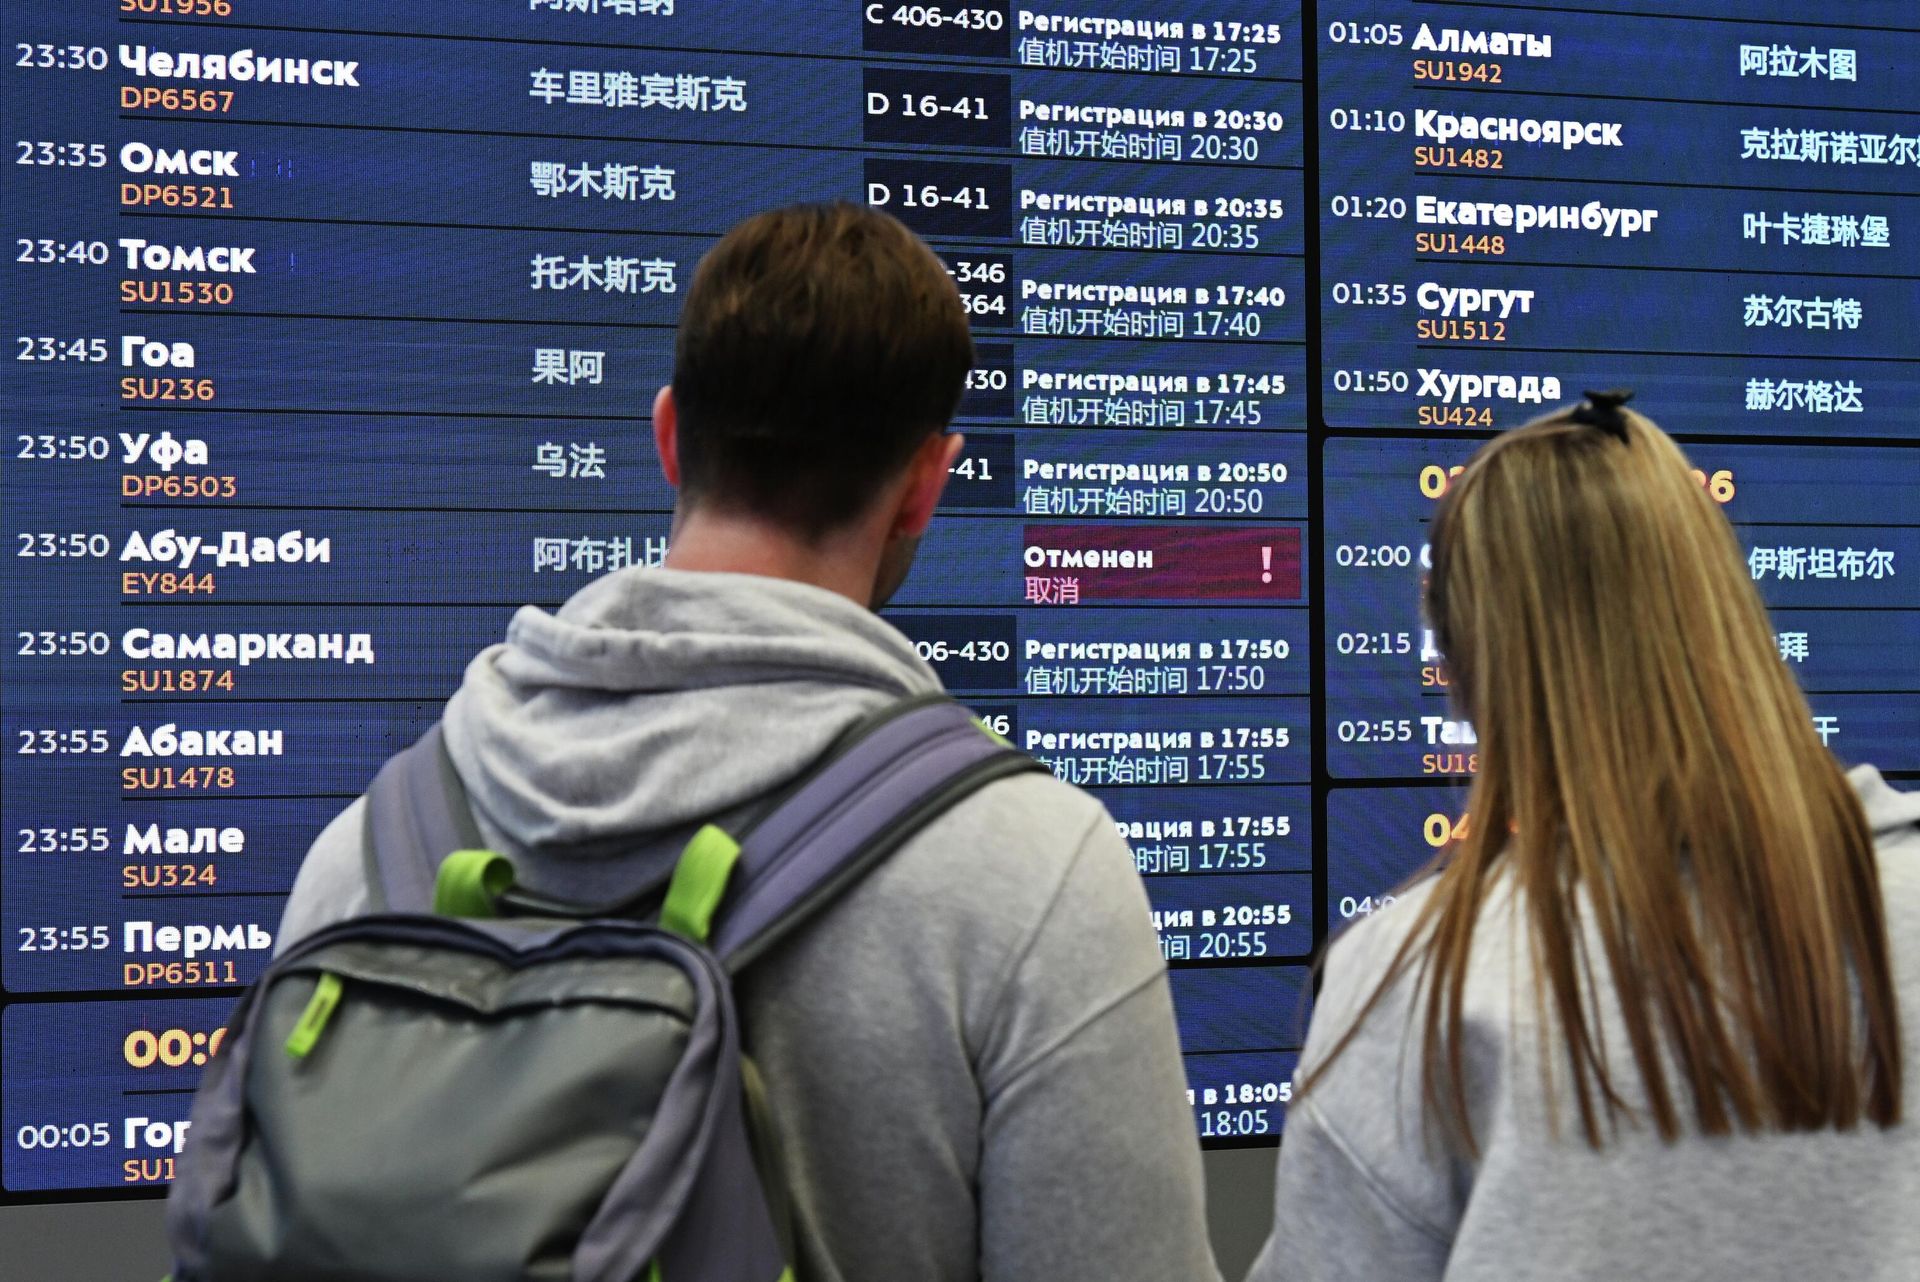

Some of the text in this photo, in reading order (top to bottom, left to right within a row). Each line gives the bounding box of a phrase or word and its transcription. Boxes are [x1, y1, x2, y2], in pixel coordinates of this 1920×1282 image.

[866, 4, 1002, 30] C 406-430
[1019, 11, 1280, 43] Регистрация в 17:25
[1329, 22, 1402, 45] 01:05
[1412, 23, 1551, 57] Алматы
[16, 44, 108, 70] 23:30
[119, 45, 359, 86] Челябинск
[1018, 37, 1256, 73] 值机开始时间 17:25
[1740, 44, 1856, 81] 阿拉木图
[1414, 60, 1501, 83] SU1942
[121, 87, 233, 112] DP6567
[530, 67, 747, 111] 车里雅宾斯克
[868, 93, 988, 119] D 16-41
[1020, 100, 1283, 133] Регистрация в 20:30
[1331, 109, 1405, 131] 01:10
[1415, 109, 1623, 150] Красноярск
[16, 141, 106, 167] 23:35
[1019, 126, 1258, 161] 值机开始时间 20:30
[1741, 127, 1920, 167] 克拉斯诺亚尔
[121, 142, 239, 176] Омск
[1415, 147, 1502, 168] SU1482
[530, 162, 676, 200] 鄂木斯克
[122, 184, 233, 208] DP6521
[869, 184, 989, 209] D 16-41
[1021, 190, 1283, 222] Регистрация в 20:35
[1332, 196, 1406, 218] 01:20
[1416, 196, 1658, 238] Екатеринбург
[1744, 212, 1890, 247] 叶卡捷琳堡
[1020, 216, 1258, 249] 值机开始时间 20:35
[1416, 233, 1505, 254] SU1448
[17, 239, 108, 264] 23:40
[120, 239, 256, 273] Томск
[531, 254, 676, 293] 托木斯克
[122, 281, 233, 304] SU1530
[1022, 280, 1285, 306] Регистрация в 17:40
[1333, 283, 1406, 305] 01:35
[1417, 283, 1534, 318] Сургут
[1021, 306, 1260, 338] 值机开始时间 17:40
[1744, 294, 1862, 330] 苏尔古特
[1417, 320, 1505, 340] SU1512
[17, 337, 107, 361] 23:45
[122, 336, 194, 367] Гоа
[532, 349, 605, 385] 果阿
[122, 378, 214, 400] SU236
[1023, 370, 1285, 395] Регистрация в 17:45
[1334, 370, 1408, 392] 01:50
[1416, 369, 1560, 403] Хургада
[1746, 378, 1863, 413] 赫尔格达
[1022, 395, 1261, 426] 值机开始时间 17:45
[1419, 407, 1493, 426] SU424
[17, 435, 109, 459] 23:50
[119, 431, 208, 471] Уфа
[532, 442, 606, 479] 乌法
[1024, 459, 1287, 485] Регистрация в 20:50
[123, 475, 236, 497] DP6503
[1023, 486, 1262, 515] 值机开始时间 20:50
[18, 534, 109, 557] 23:50
[119, 529, 330, 568] Абу-Даби
[1024, 546, 1152, 568] Отменен
[1336, 545, 1410, 566] 02:00
[1748, 547, 1895, 580] 伊斯坦布尔
[123, 573, 215, 593] EY844
[1025, 577, 1079, 604] 取消
[18, 632, 110, 655] 23:50
[123, 628, 374, 665] Самарканд
[908, 641, 1009, 661] 06-430
[1026, 640, 1289, 664] Регистрация в 17:50
[1337, 633, 1410, 654] 02:15
[1772, 632, 1809, 662] 拜
[123, 670, 234, 691] SU1874
[1025, 666, 1264, 694] 值机开始时间 17:50
[18, 730, 108, 753] 23:55
[120, 723, 282, 756] Абакан
[1027, 728, 1289, 753] Регистрация в 17:55
[1338, 720, 1411, 741] 02:55
[123, 767, 234, 789] SU1478
[1036, 754, 1264, 784] 机开始时间 17:55
[124, 824, 244, 854] Мале
[1202, 821, 1215, 837] в
[1223, 816, 1290, 836] 17:55
[19, 828, 109, 852] 23:55
[1199, 843, 1265, 868] 17:55
[124, 865, 216, 887] SU324
[1202, 910, 1216, 926] в
[1223, 905, 1291, 925] 20:55
[19, 926, 109, 951] 23:55
[124, 921, 271, 958] Пермь
[1200, 932, 1266, 957] 20:55
[125, 961, 237, 985] DP6511
[1204, 1089, 1217, 1104] в
[1226, 1082, 1292, 1103] 18:05
[1202, 1109, 1268, 1136] 18:05
[18, 1123, 110, 1149] 00:05
